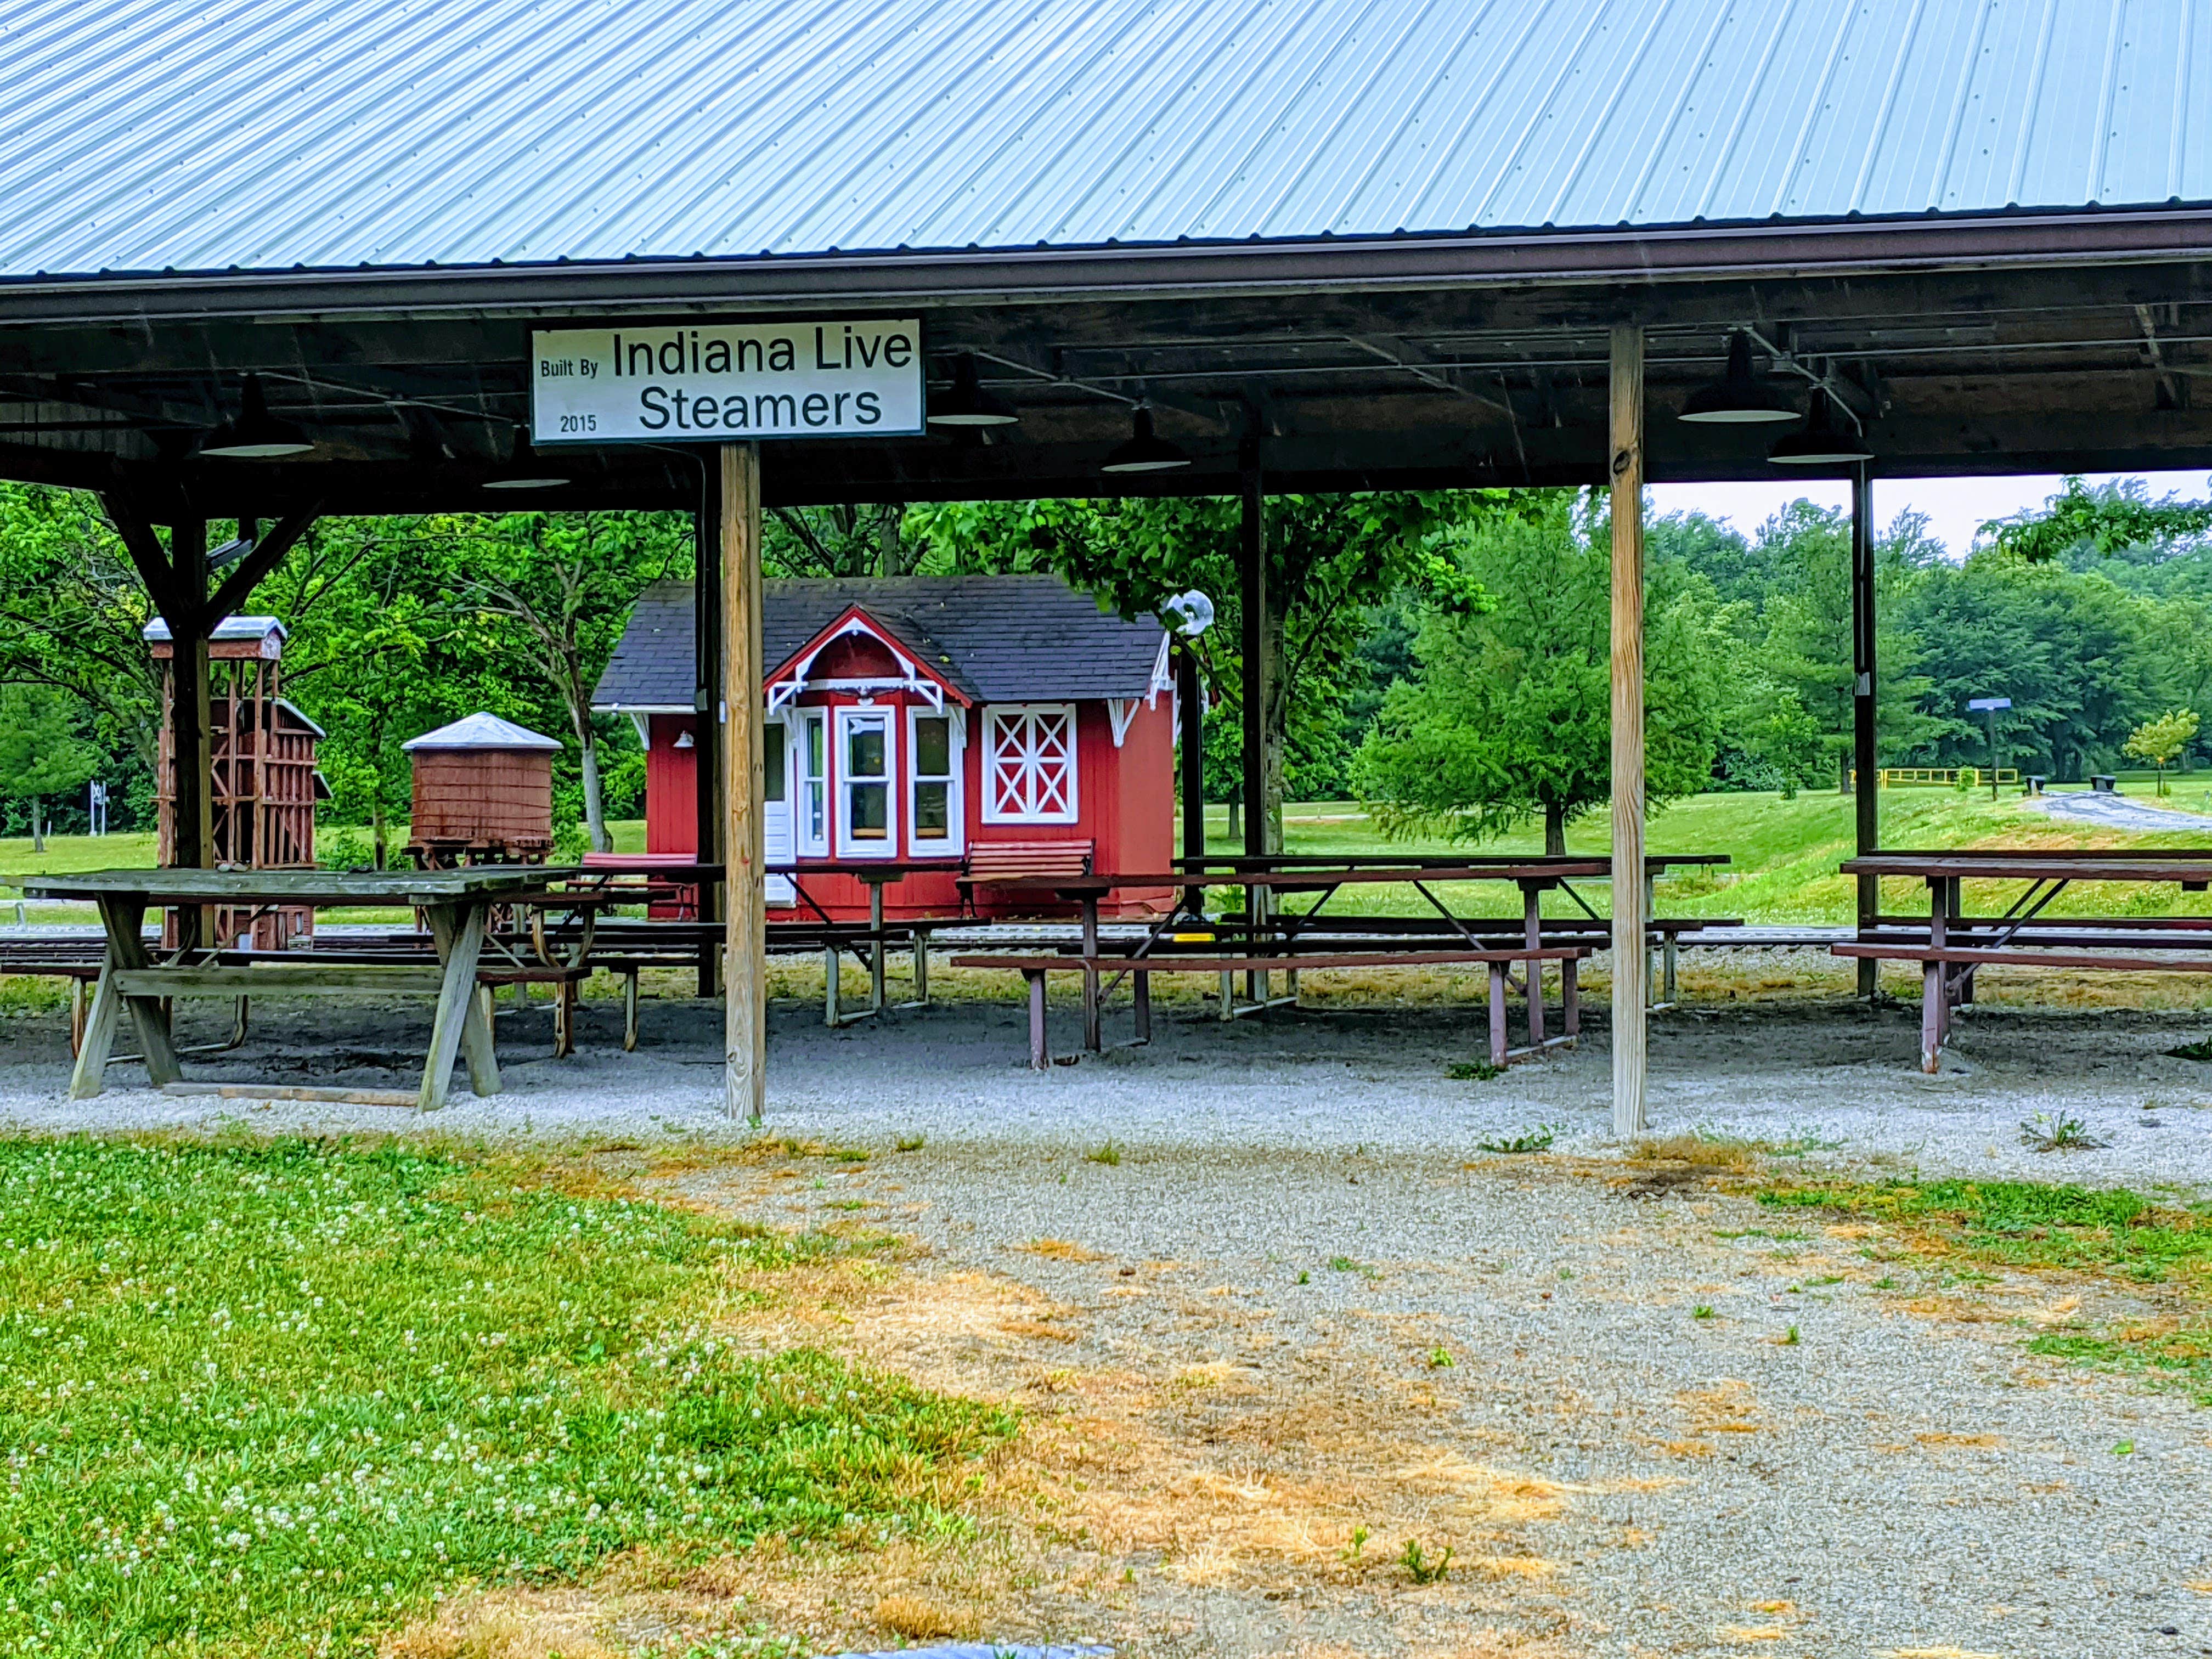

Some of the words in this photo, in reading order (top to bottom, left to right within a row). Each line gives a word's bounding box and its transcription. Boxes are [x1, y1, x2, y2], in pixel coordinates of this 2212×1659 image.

[614, 330, 795, 377] Indiana
[814, 326, 912, 370] Live
[540, 359, 574, 377] Built
[580, 358, 599, 380] By
[560, 414, 596, 432] 2015
[640, 386, 882, 430] Steamers
